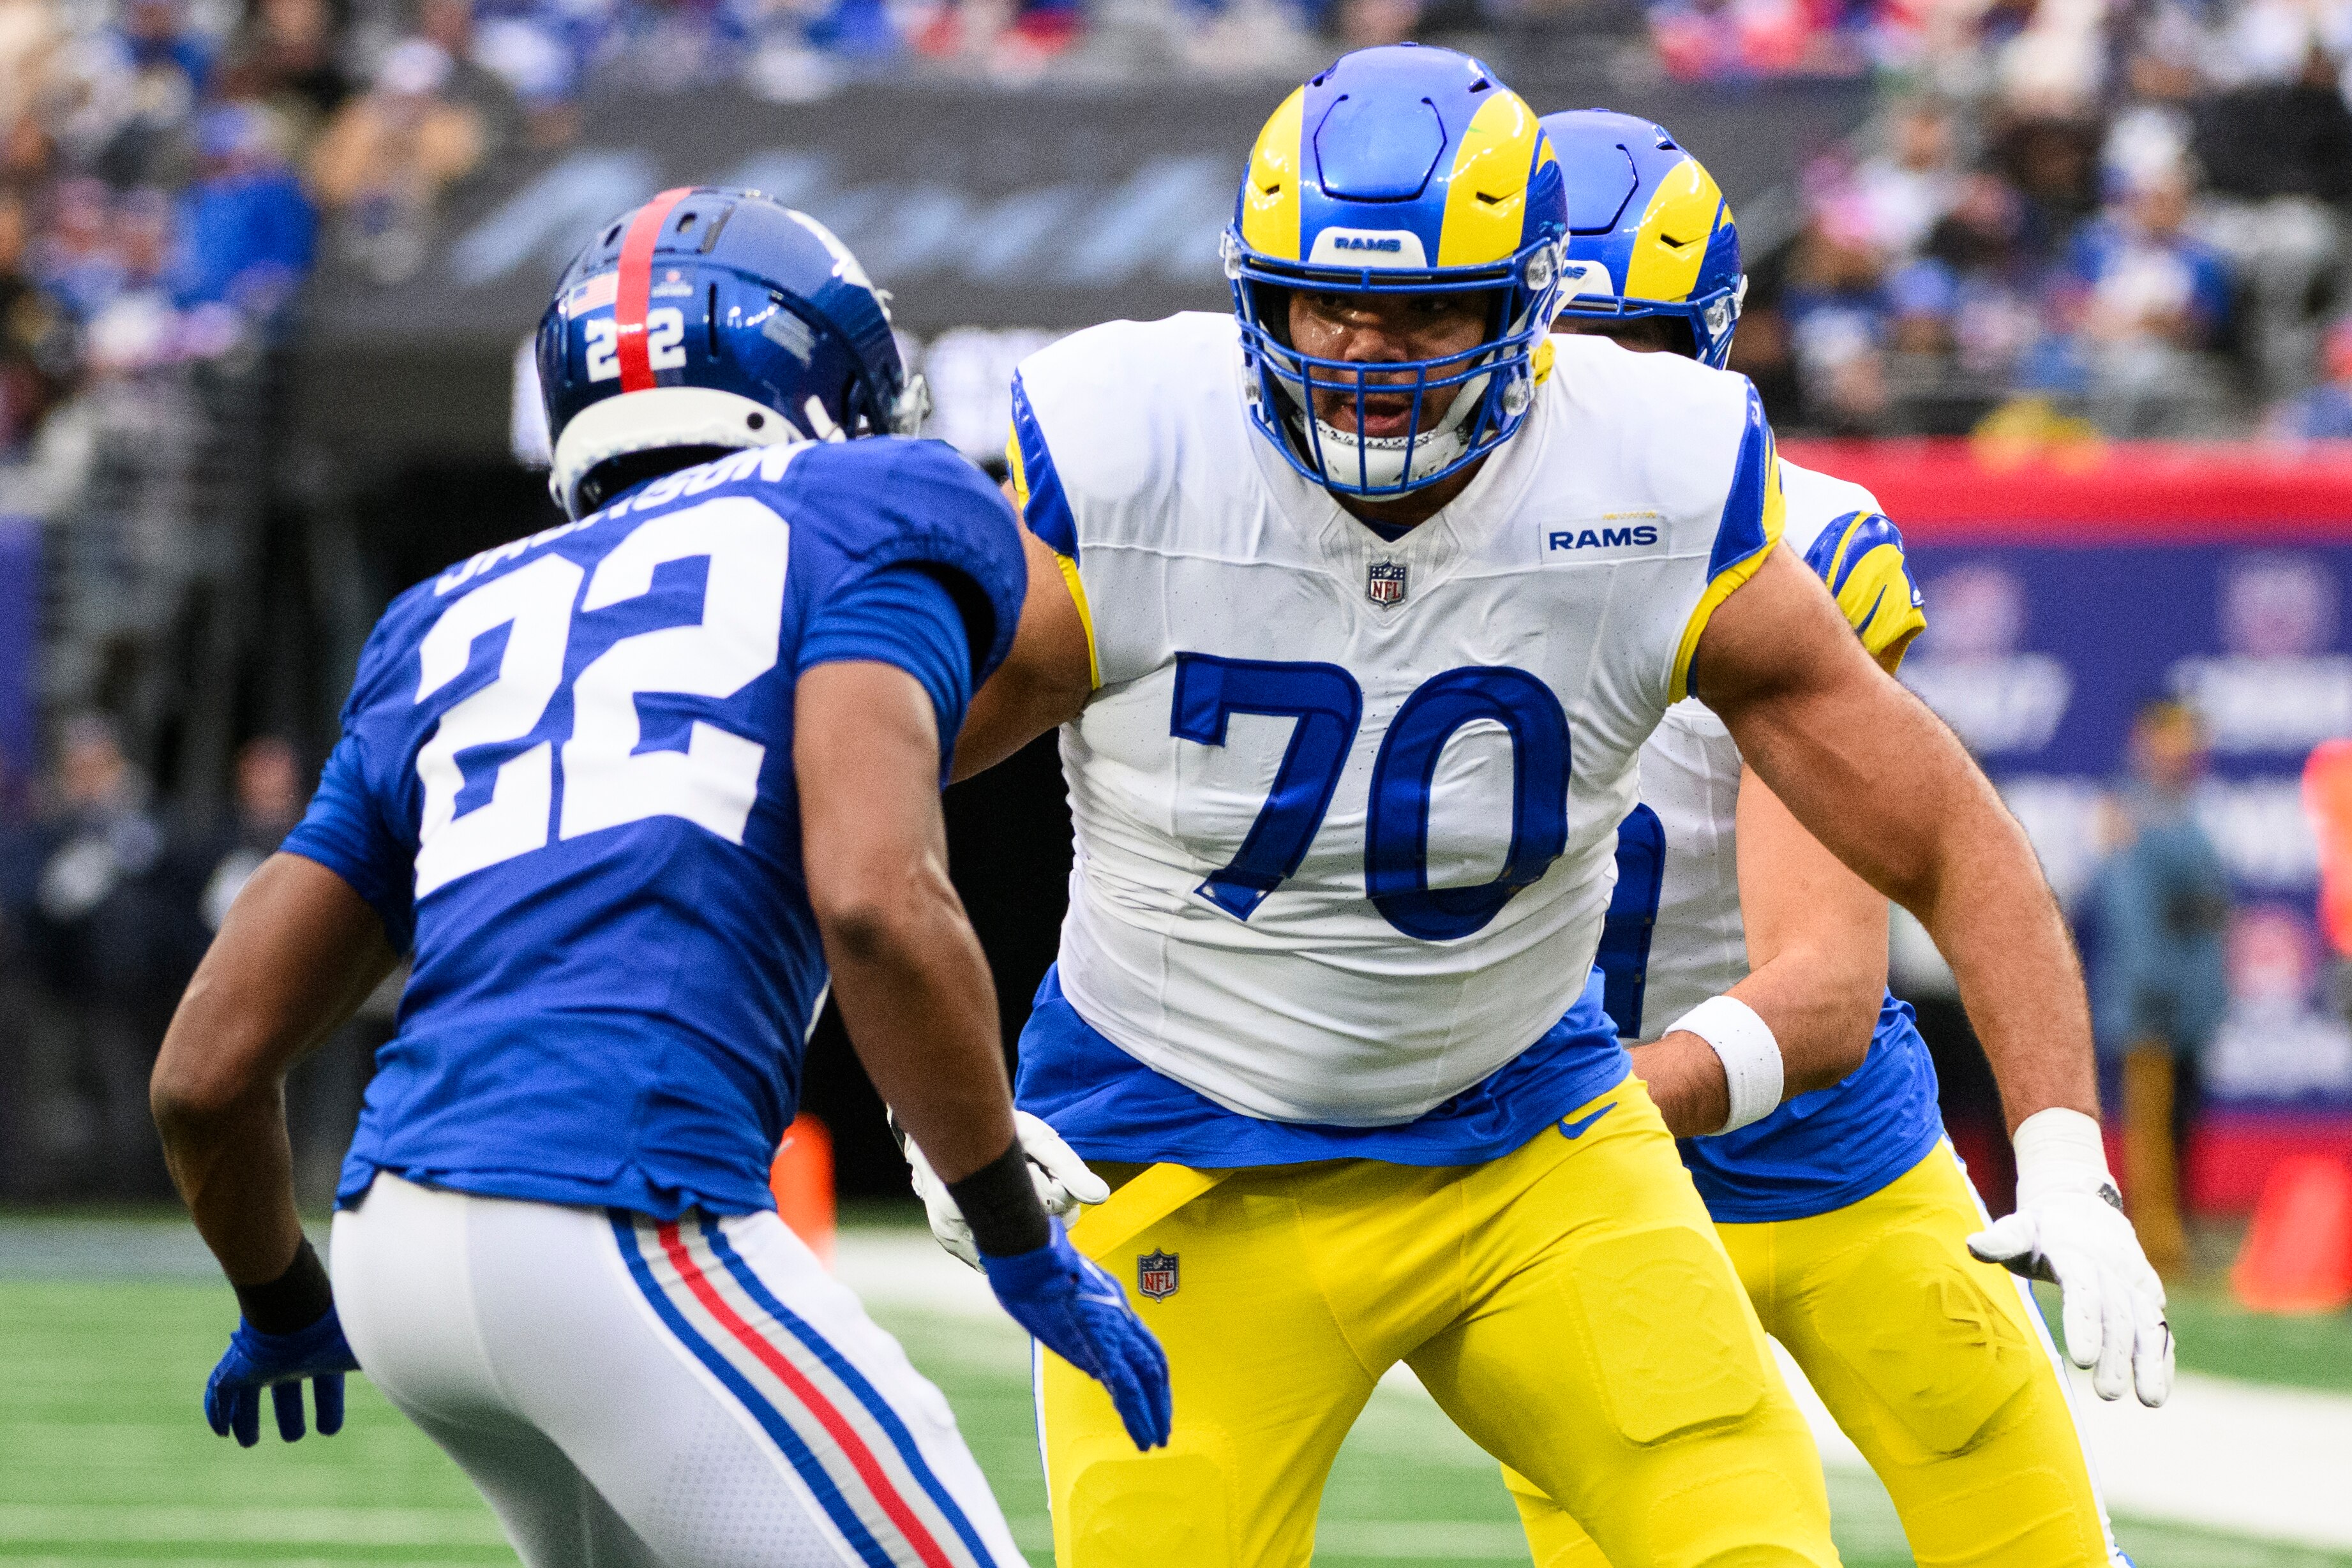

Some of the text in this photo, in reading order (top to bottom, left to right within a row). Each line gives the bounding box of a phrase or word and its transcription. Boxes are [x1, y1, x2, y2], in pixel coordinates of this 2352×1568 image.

[1334, 237, 1401, 252] RAMS
[585, 307, 687, 383] 22
[433, 440, 817, 597] JASON
[1549, 525, 1658, 551] RAMS
[1372, 581, 1401, 601] NFL
[414, 496, 790, 900] 22
[1170, 650, 1572, 941] 70
[1144, 1271, 1173, 1292] NFL
